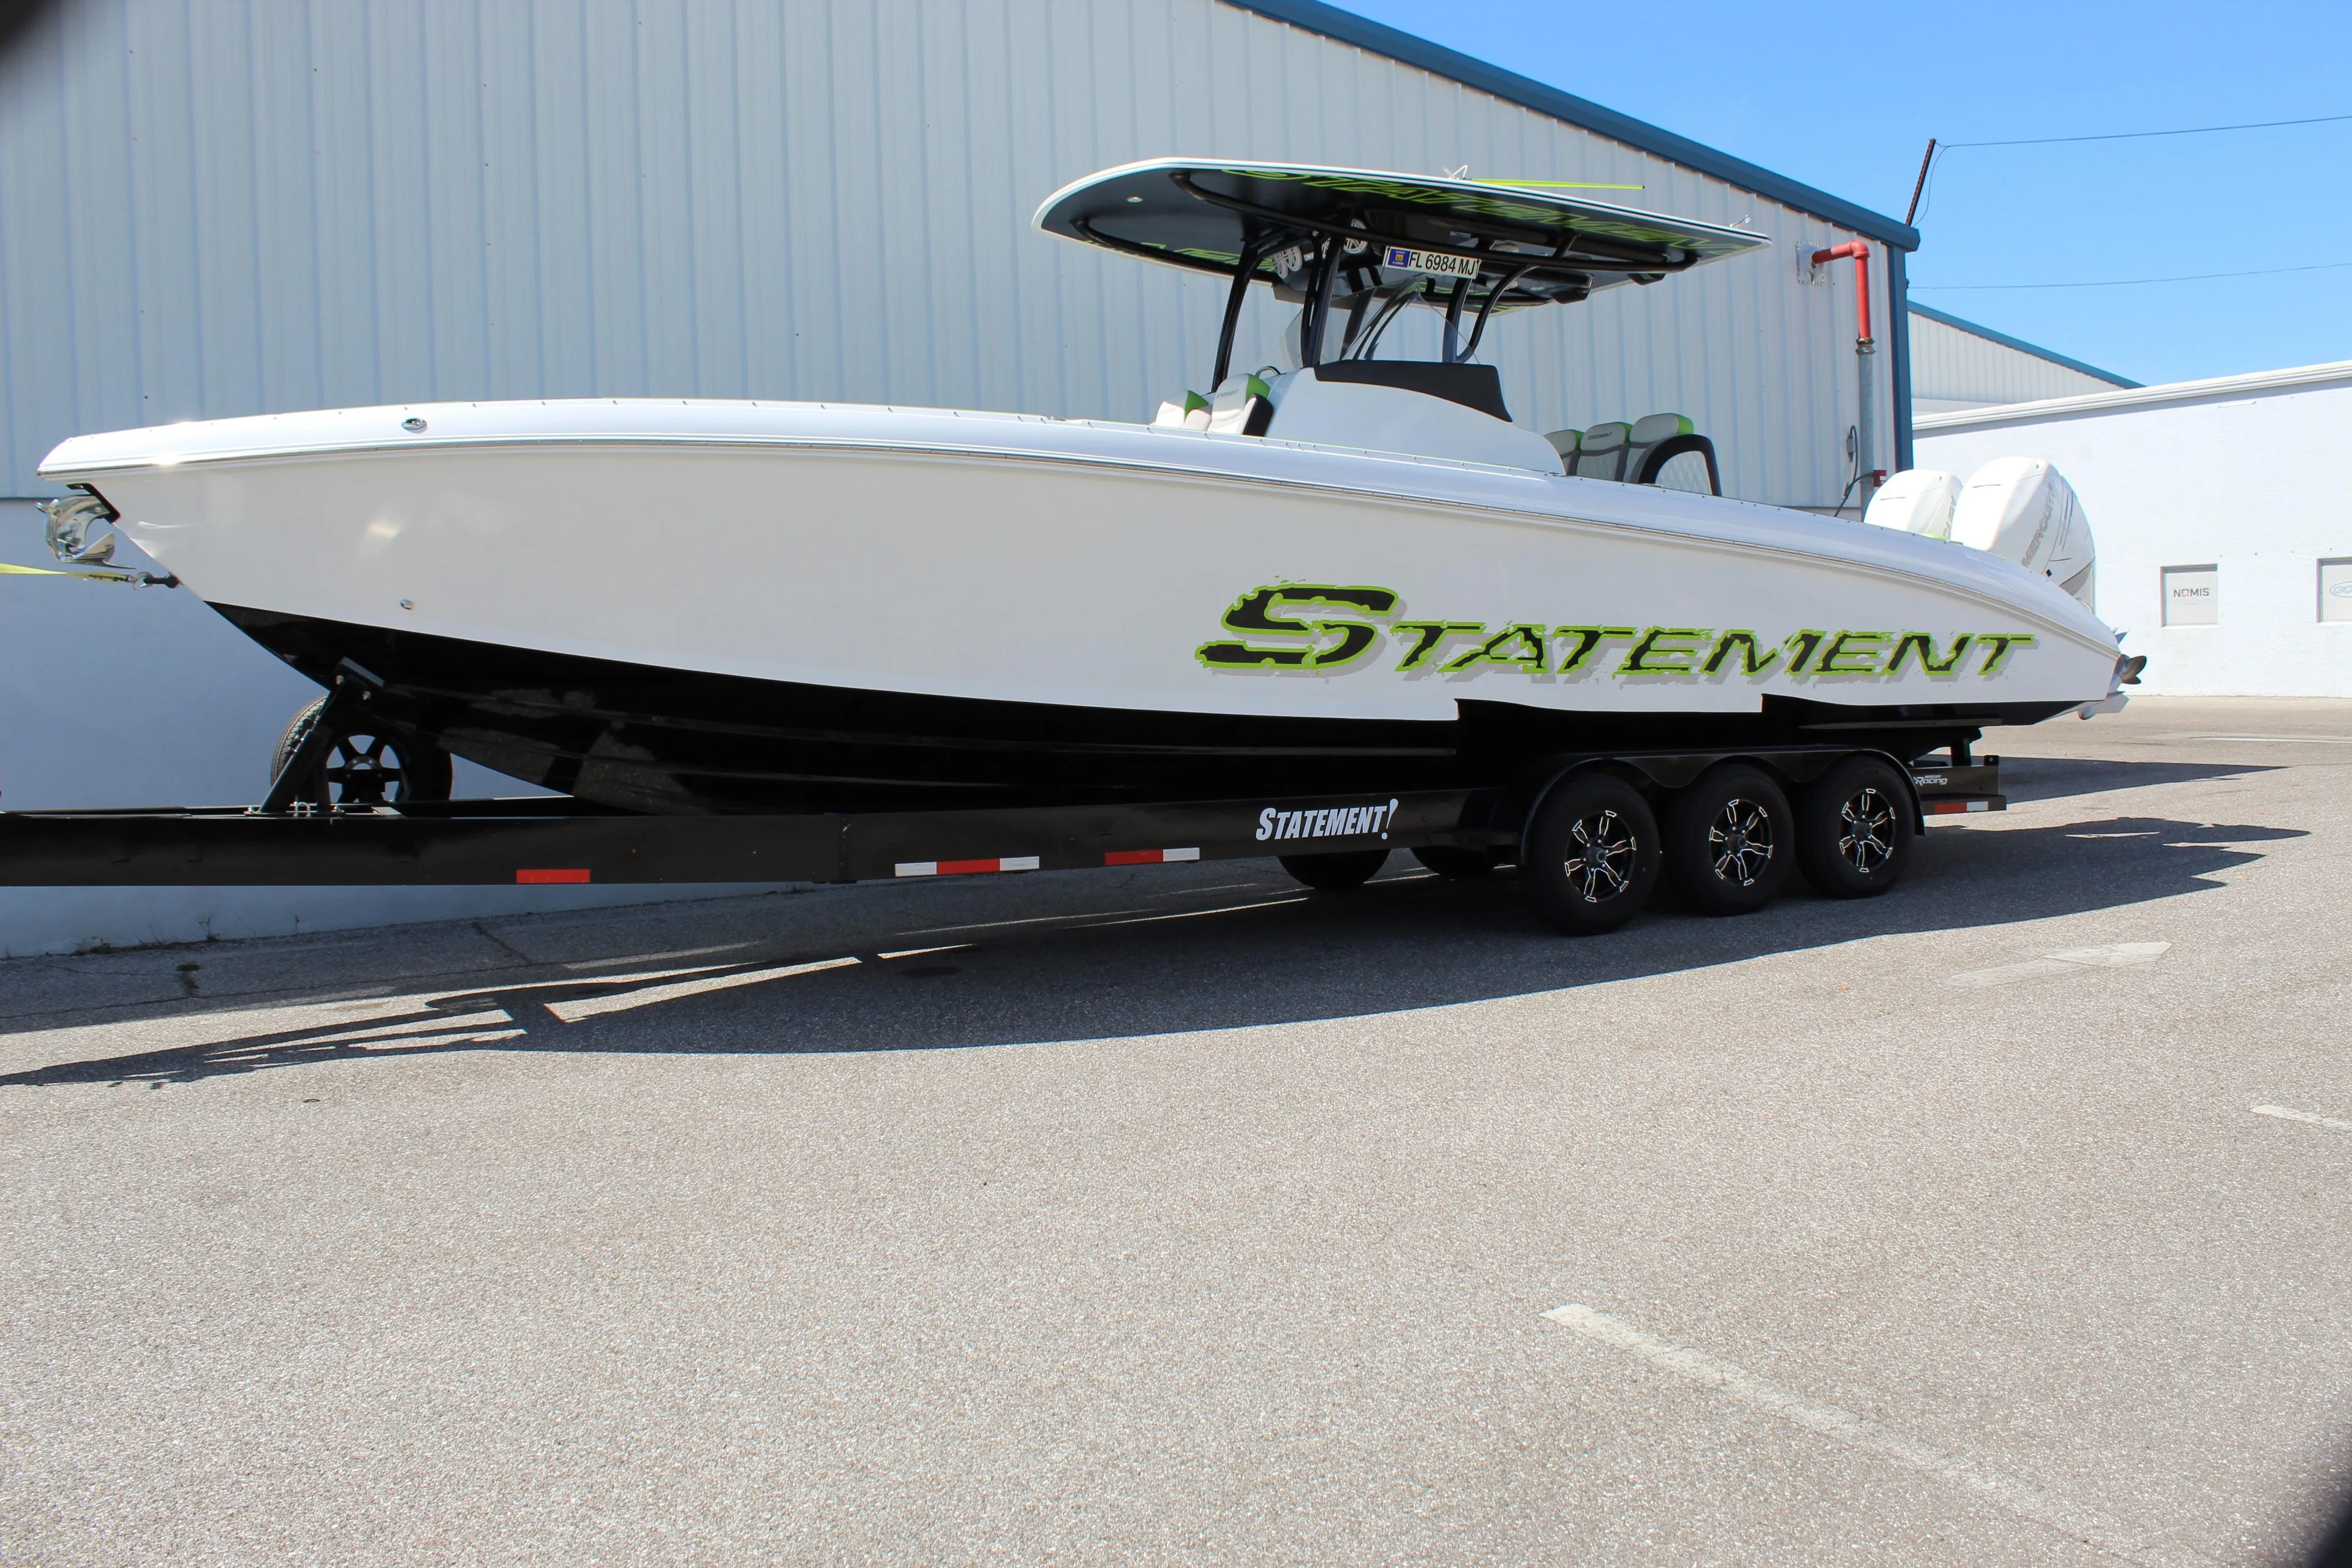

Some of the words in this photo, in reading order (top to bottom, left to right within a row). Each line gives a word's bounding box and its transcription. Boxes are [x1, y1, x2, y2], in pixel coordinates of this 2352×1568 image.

[1408, 252, 1422, 268] FL
[1425, 254, 1456, 273] 6984
[1458, 259, 1476, 276] MJ
[2021, 483, 2056, 568] MERCURY
[1195, 581, 2034, 679] STATEMENT
[1913, 777, 1948, 786] Racing
[1256, 798, 1399, 841] STATEMENT!
